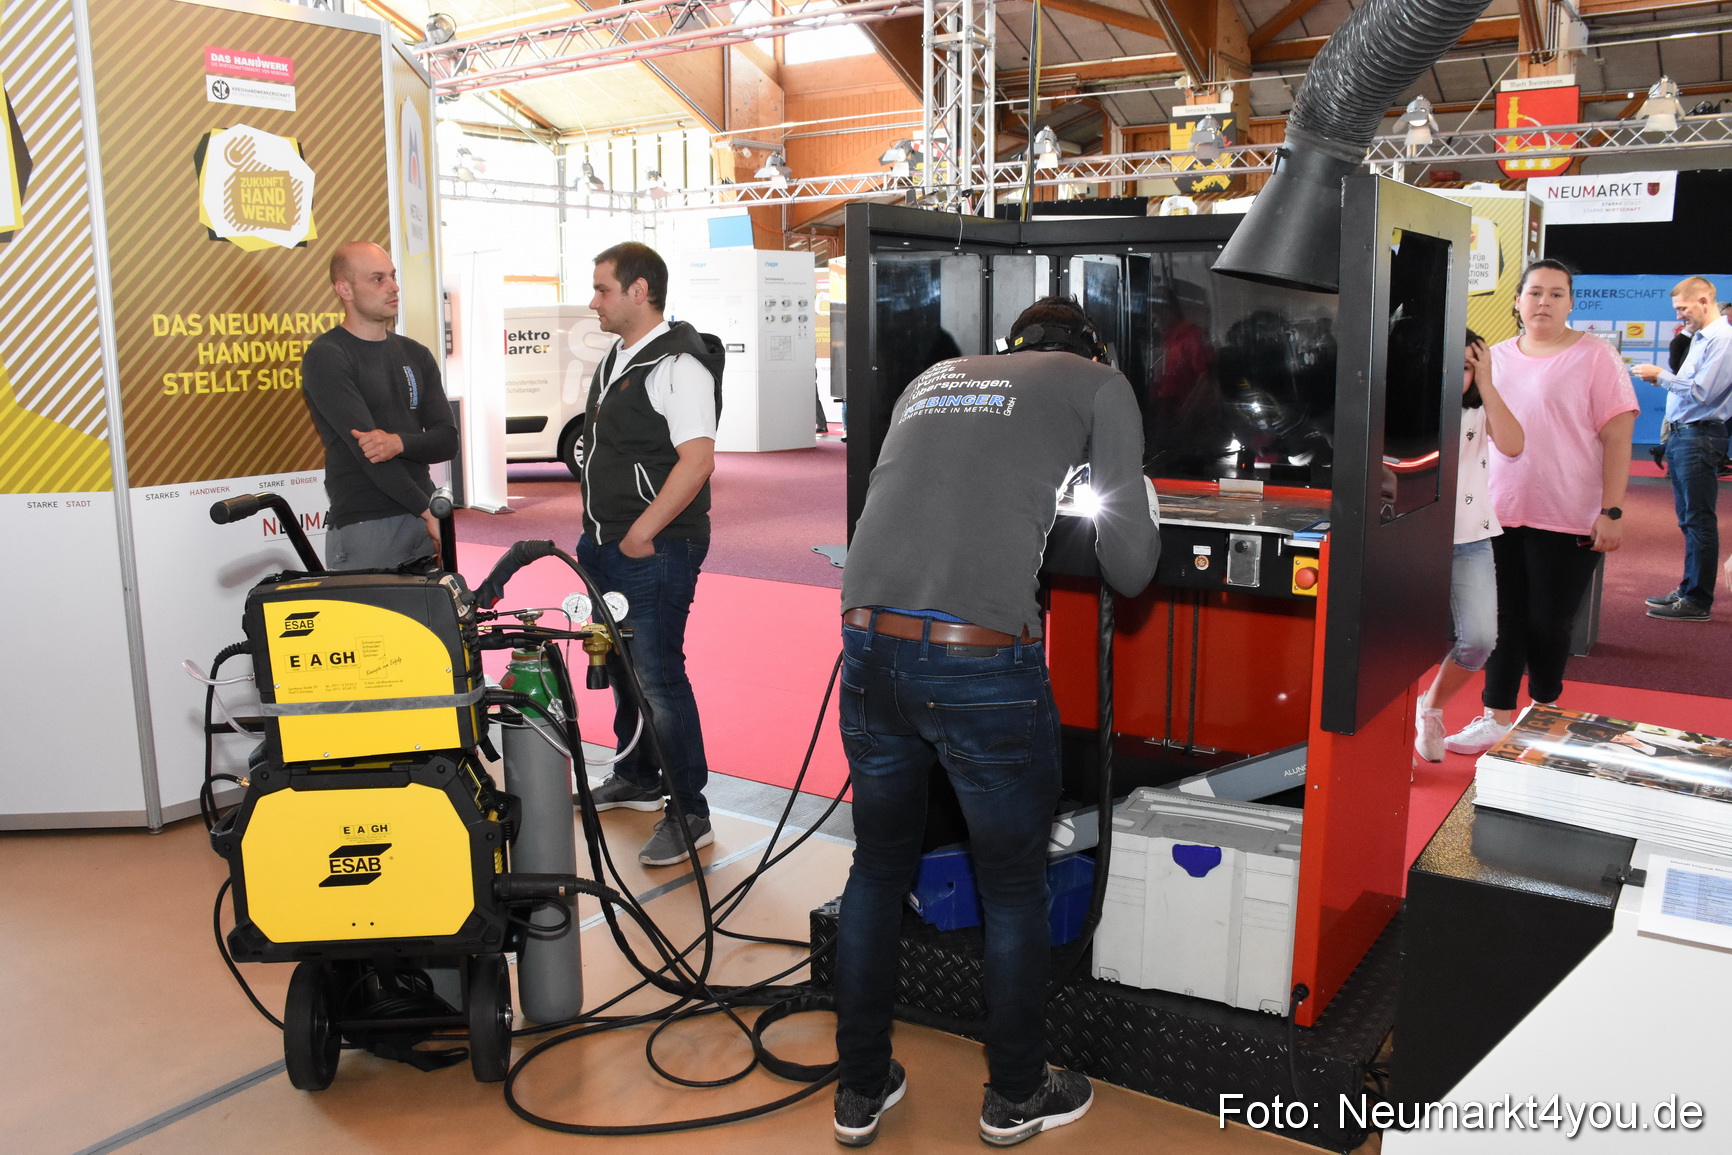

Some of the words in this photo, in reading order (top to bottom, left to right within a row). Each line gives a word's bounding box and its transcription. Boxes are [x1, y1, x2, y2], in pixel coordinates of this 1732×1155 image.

[210, 52, 232, 63] DAS
[234, 56, 289, 72] HANDWERK
[232, 86, 291, 98] KREISHANDWERKERSCHAFT
[240, 176, 284, 188] ZUKUNFT
[241, 187, 286, 206] HAND
[1548, 183, 1642, 199] NEUMARKT
[241, 204, 287, 224] WERK
[152, 314, 202, 336] DAS
[508, 330, 550, 342] ektro
[508, 344, 550, 355] arrer
[162, 370, 252, 396] STELLT
[964, 406, 1001, 414] METALL
[1003, 396, 1018, 416] GmbH
[258, 480, 285, 489] STARKE
[290, 476, 318, 486] BÜRGER
[145, 491, 180, 501] STARKES
[189, 486, 231, 496] HANDWERK
[27, 500, 58, 509] STARKE
[284, 620, 314, 630] ESAB
[290, 656, 301, 668] E
[310, 654, 322, 666] A
[330, 651, 356, 665] GH
[344, 826, 350, 834] E
[358, 826, 365, 834] A
[371, 824, 388, 832] GH
[329, 857, 382, 874] ESAB
